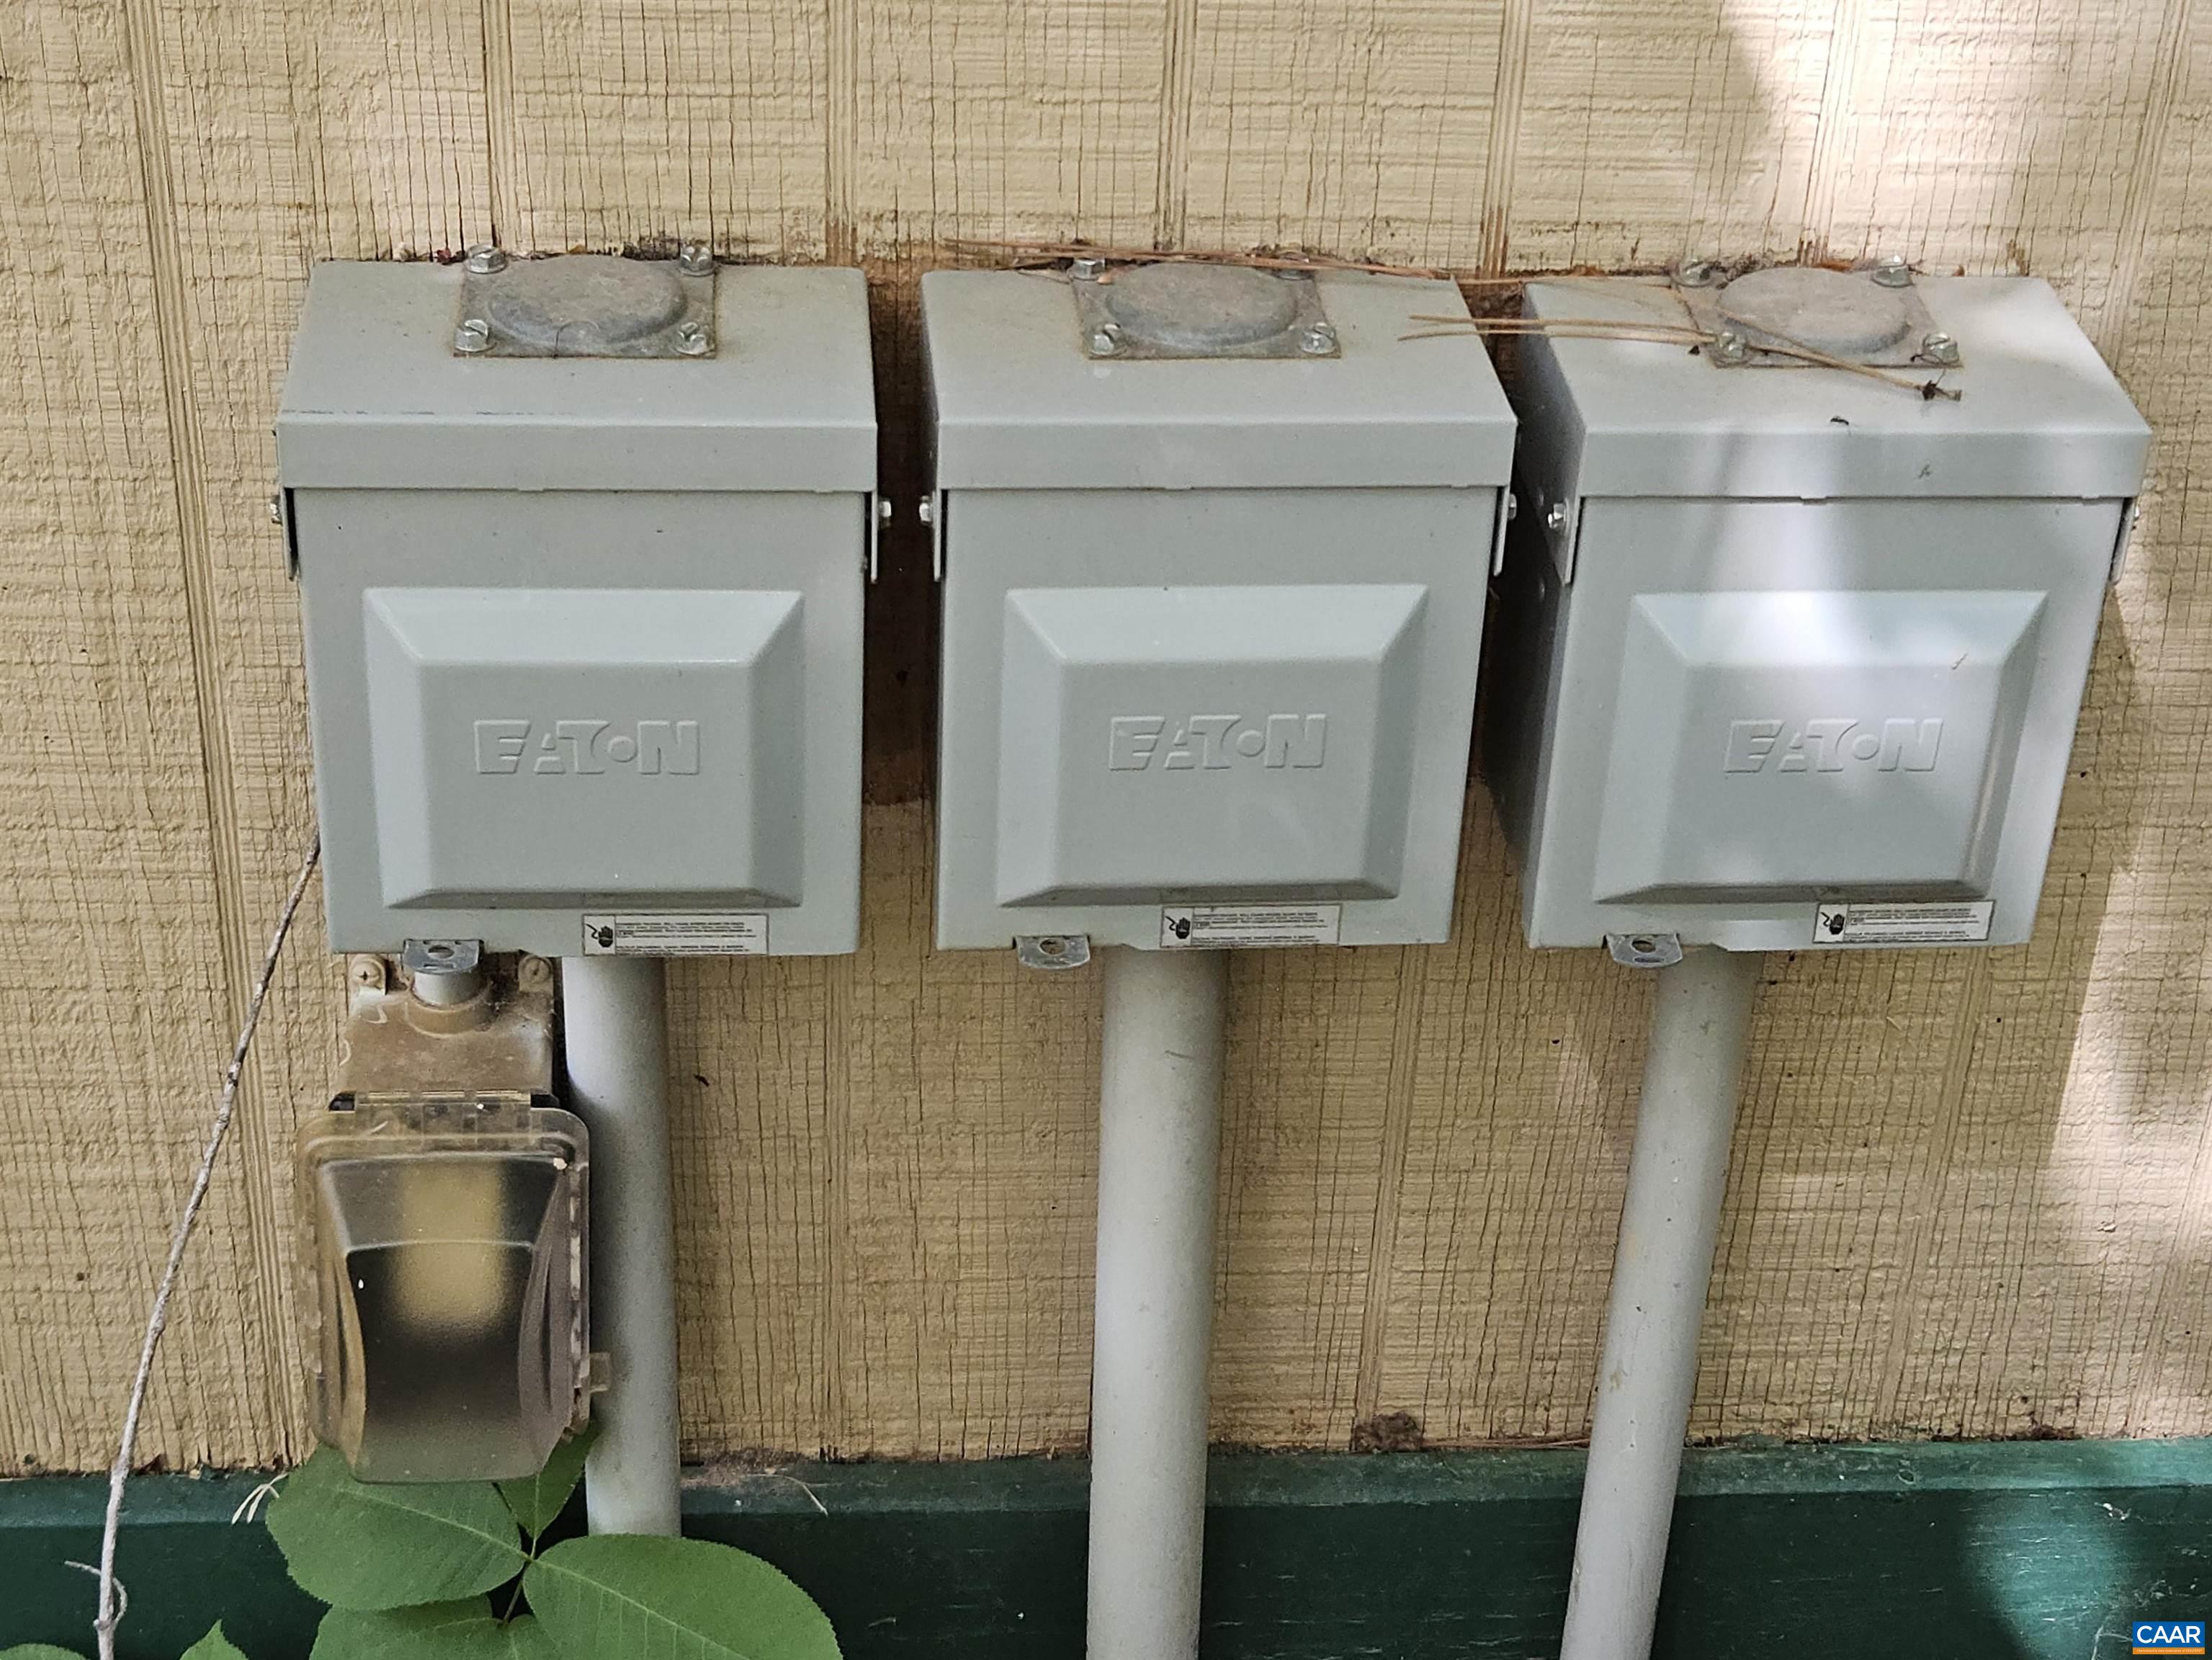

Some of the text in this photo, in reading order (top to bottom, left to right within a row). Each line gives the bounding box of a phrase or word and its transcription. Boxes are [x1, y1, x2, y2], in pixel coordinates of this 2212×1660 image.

[473, 720, 699, 775] EATON
[1109, 714, 1327, 771] EATON
[1724, 718, 1943, 773] EATON
